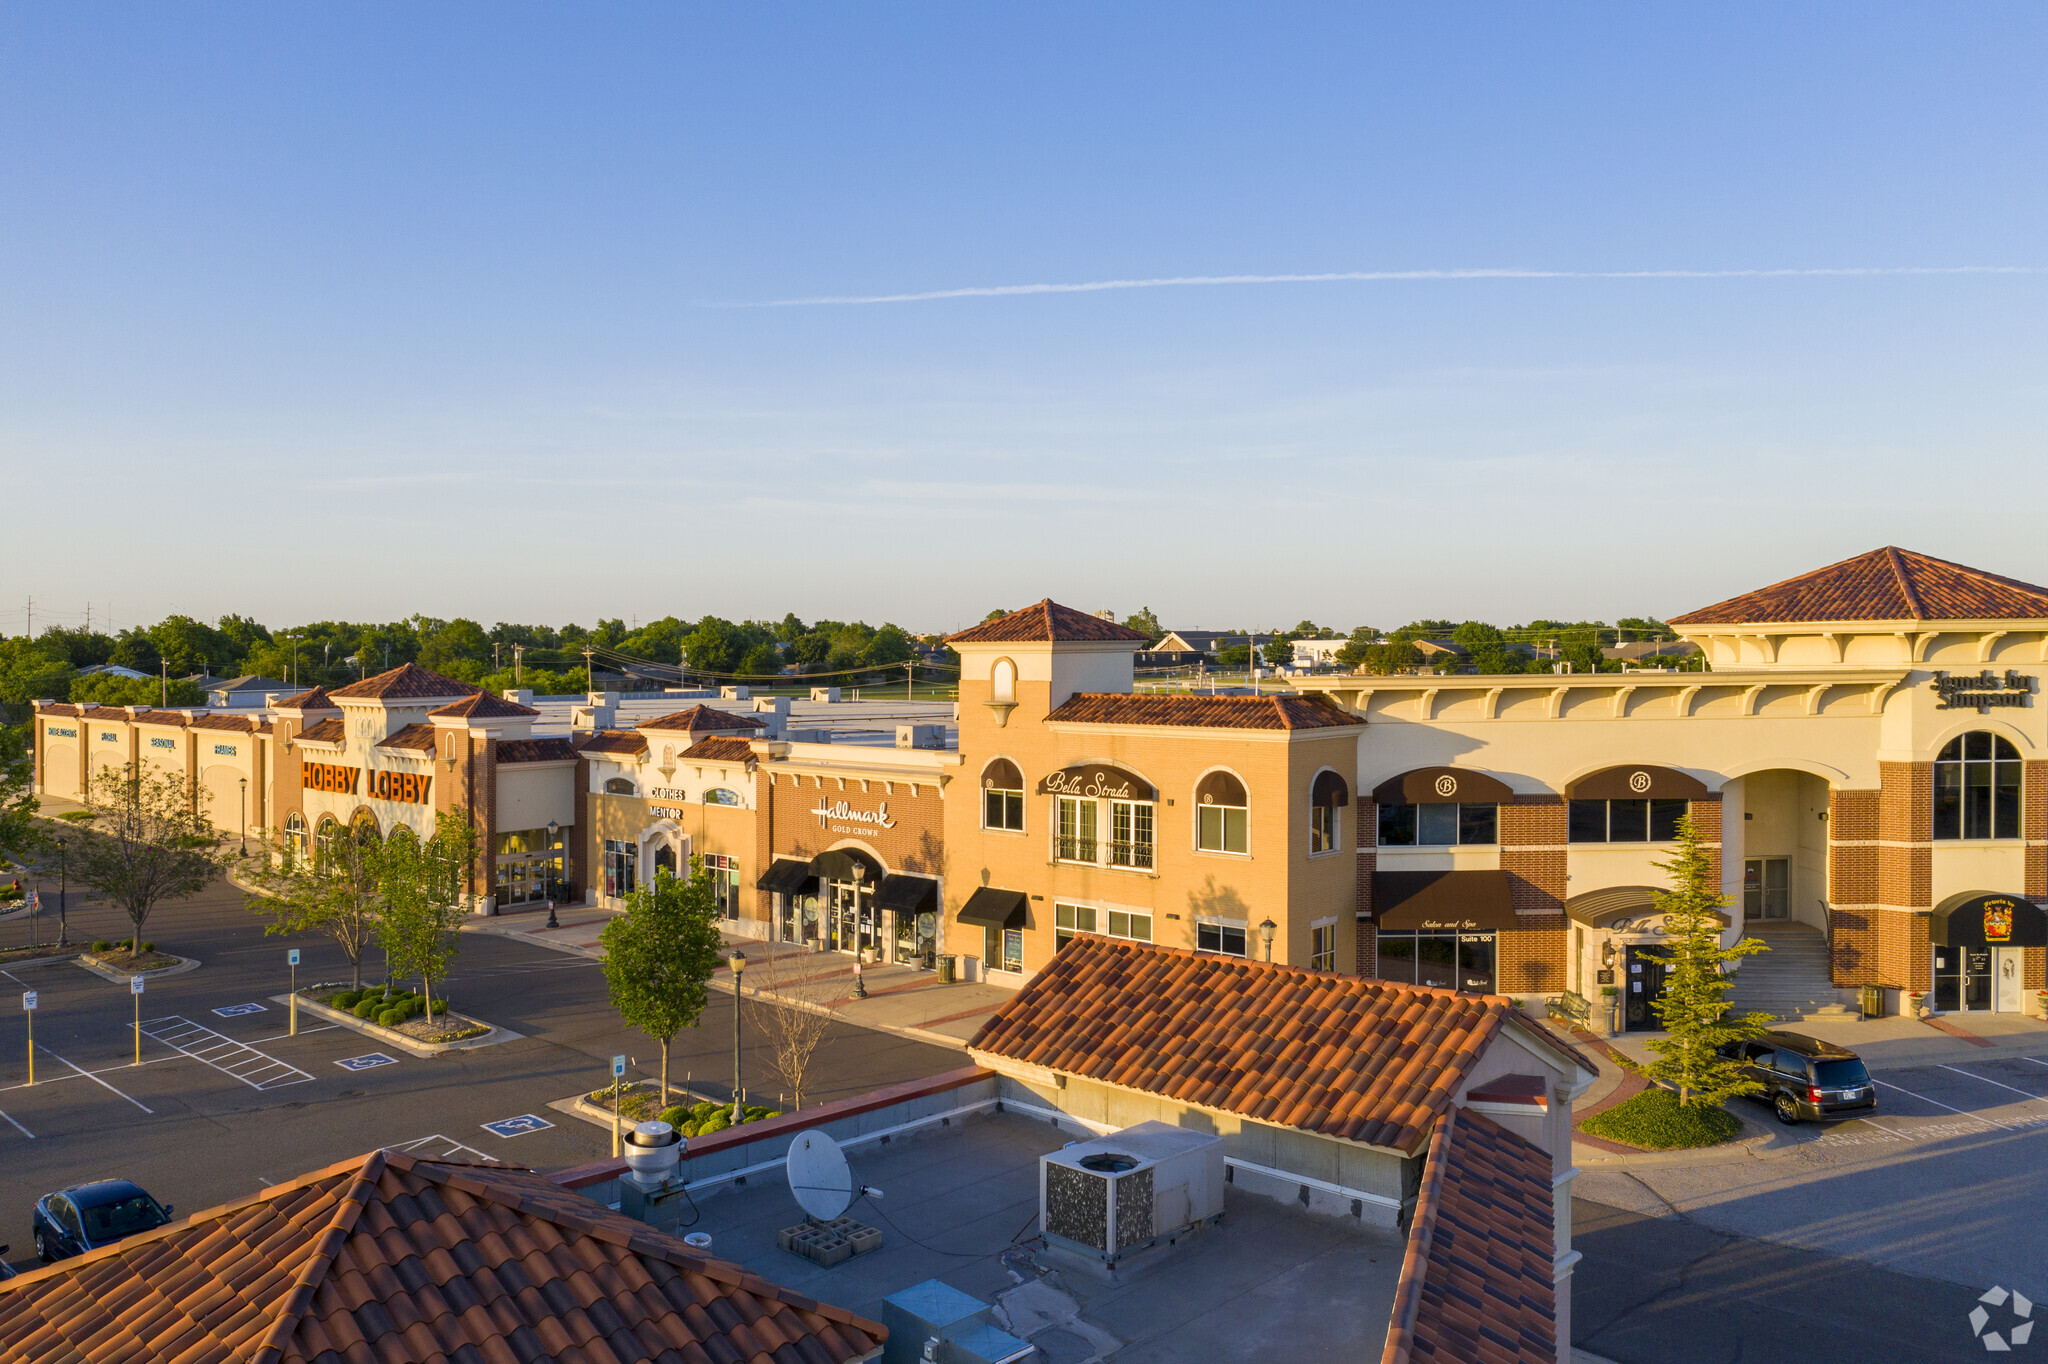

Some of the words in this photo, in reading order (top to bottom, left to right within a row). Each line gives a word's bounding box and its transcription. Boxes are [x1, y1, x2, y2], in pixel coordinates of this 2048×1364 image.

[1936, 690, 2027, 714] Simpson
[214, 744, 237, 756] FRAMES
[302, 762, 361, 795] HOBBY
[367, 768, 432, 805] LOBBY
[1046, 771, 1082, 794] Bella
[1085, 772, 1130, 798] Strada
[651, 787, 685, 800] CLOTHES
[650, 806, 683, 820] MENTOR
[811, 796, 897, 829] Hallmark
[832, 825, 851, 834] GOLD
[853, 827, 878, 837] CROWN
[1421, 920, 1442, 929] Salon
[1462, 920, 1477, 929] Spa
